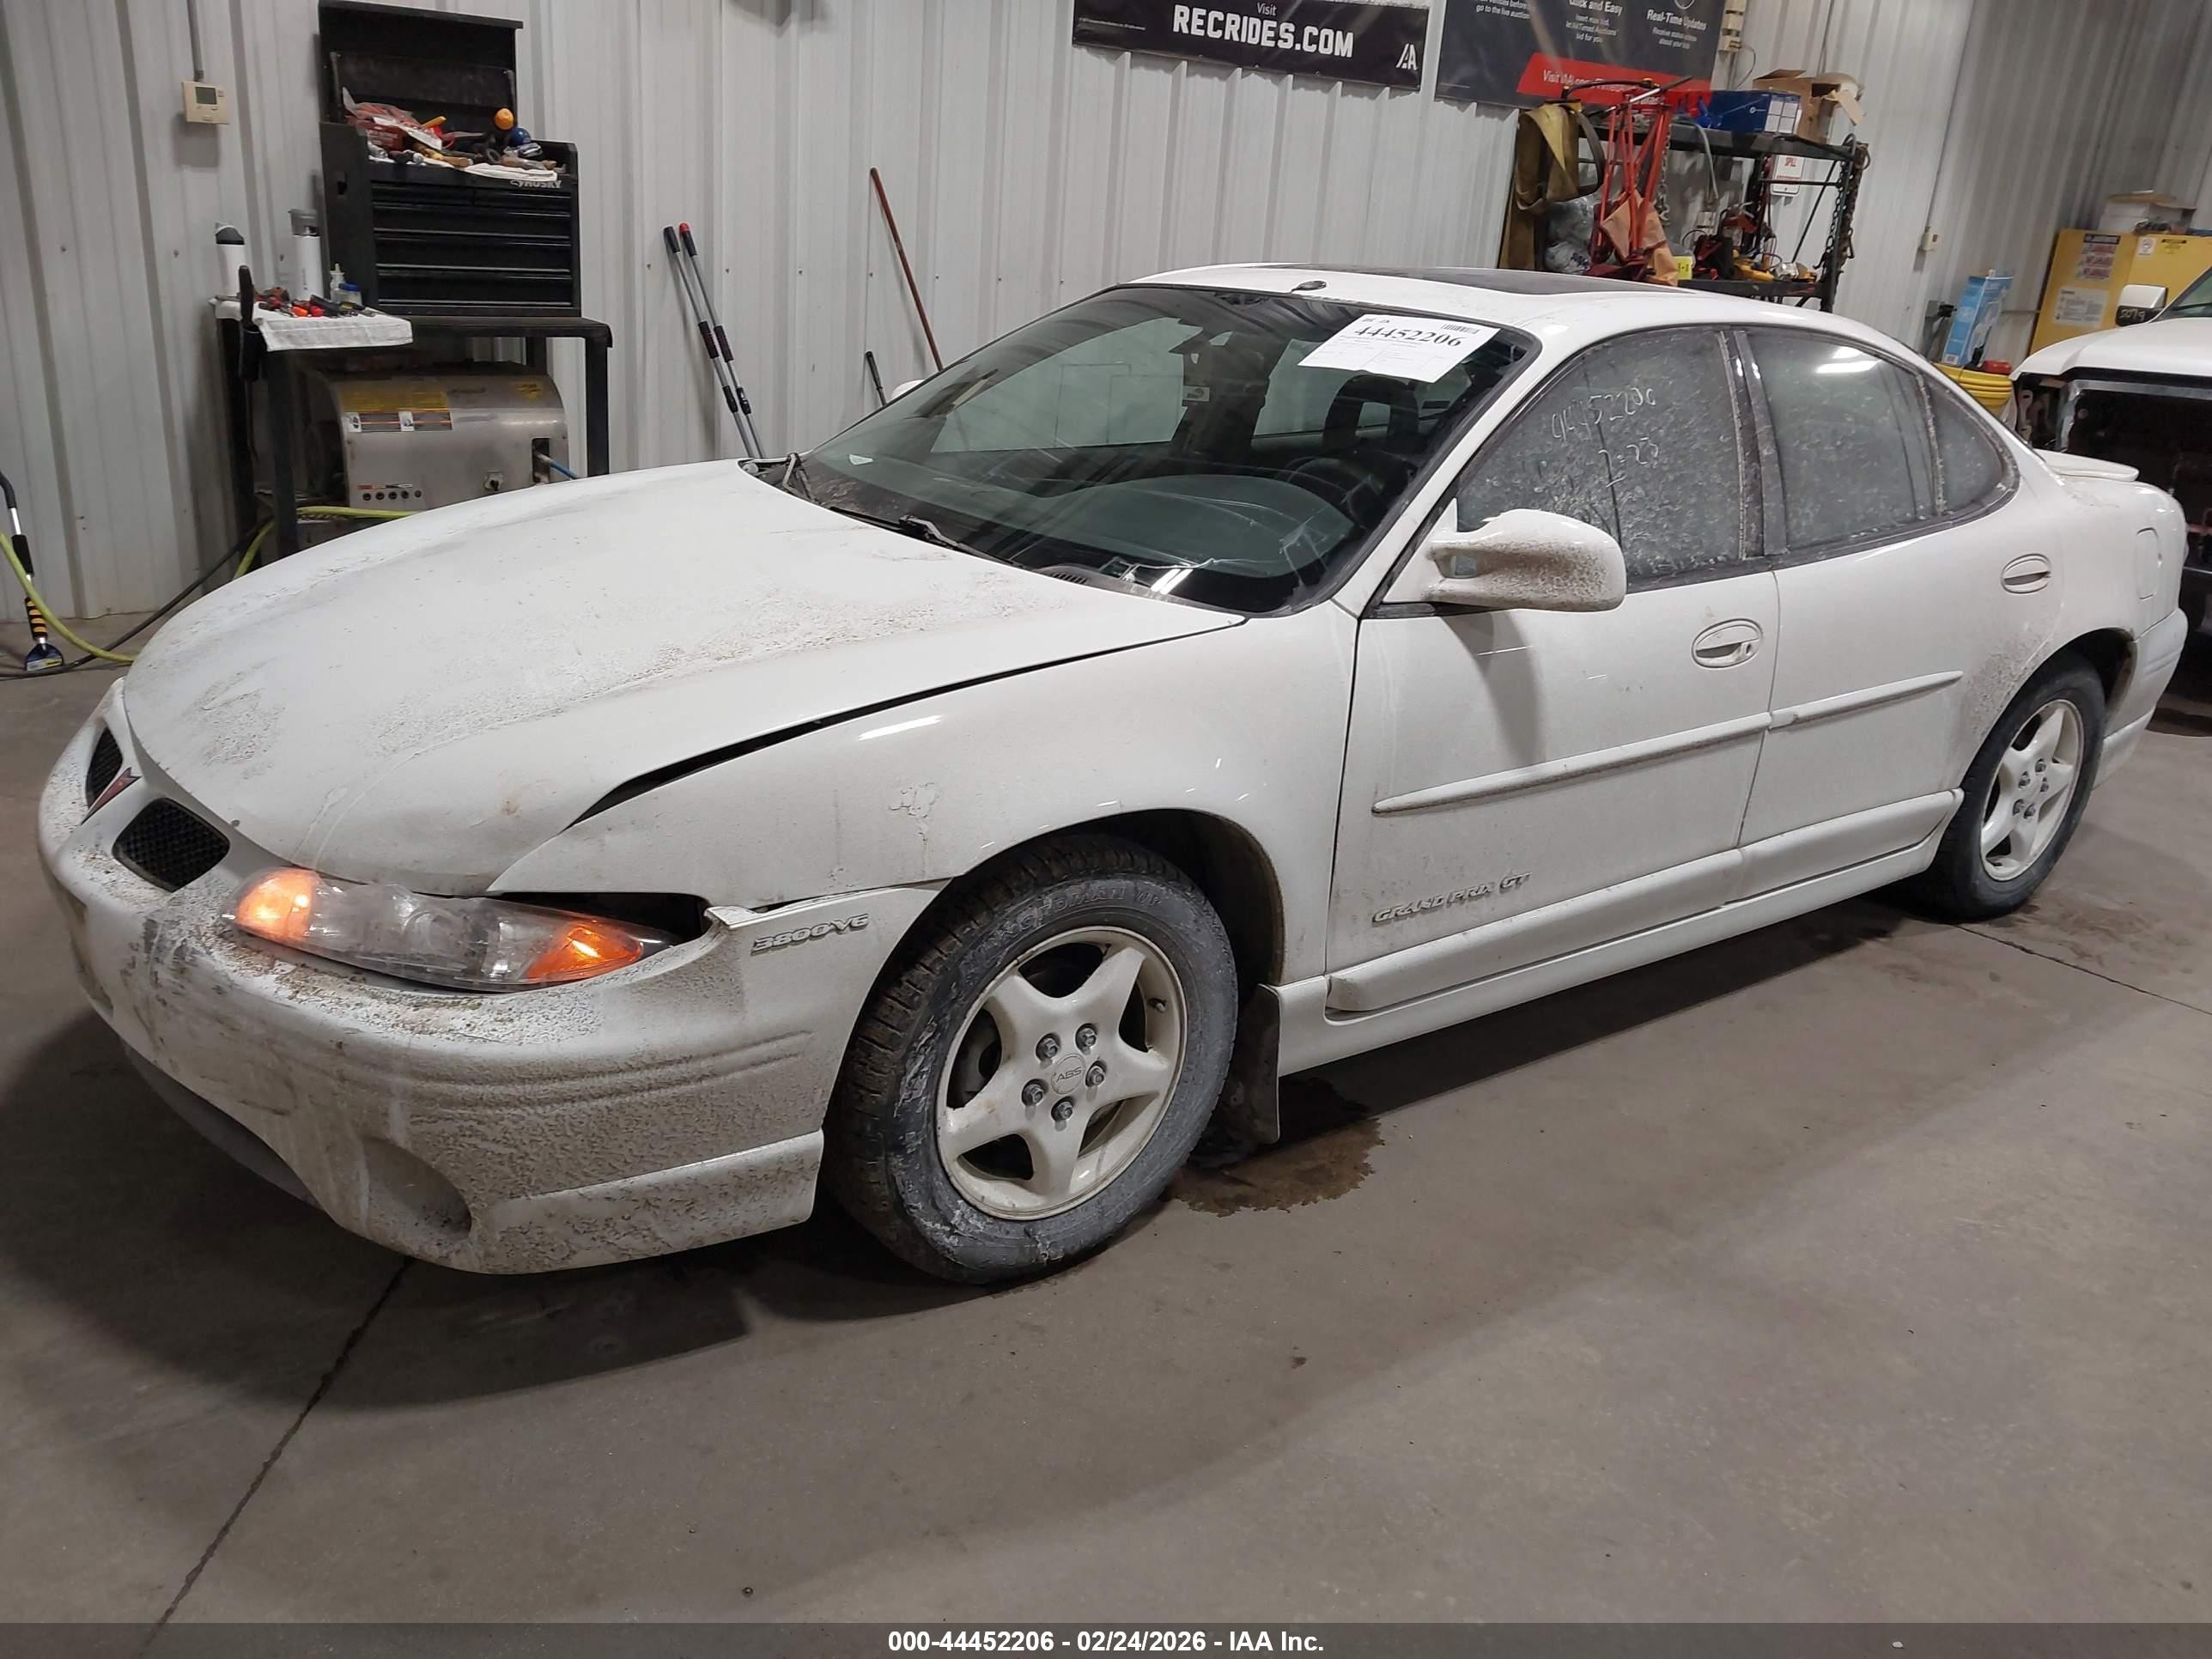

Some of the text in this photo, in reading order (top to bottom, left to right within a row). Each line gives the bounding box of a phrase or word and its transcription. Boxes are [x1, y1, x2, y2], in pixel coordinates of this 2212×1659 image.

[1257, 3, 1277, 15] Visit
[1605, 1, 1623, 16] Easy
[1647, 9, 1683, 26] Real-Time
[1173, 4, 1354, 58] RECRIDES.COM
[1543, 69, 1560, 83] Visit
[1354, 325, 1466, 347] 44452206
[1373, 895, 1445, 923] GRAND
[1499, 872, 1532, 891] GT
[1056, 1066, 1082, 1083] ABS
